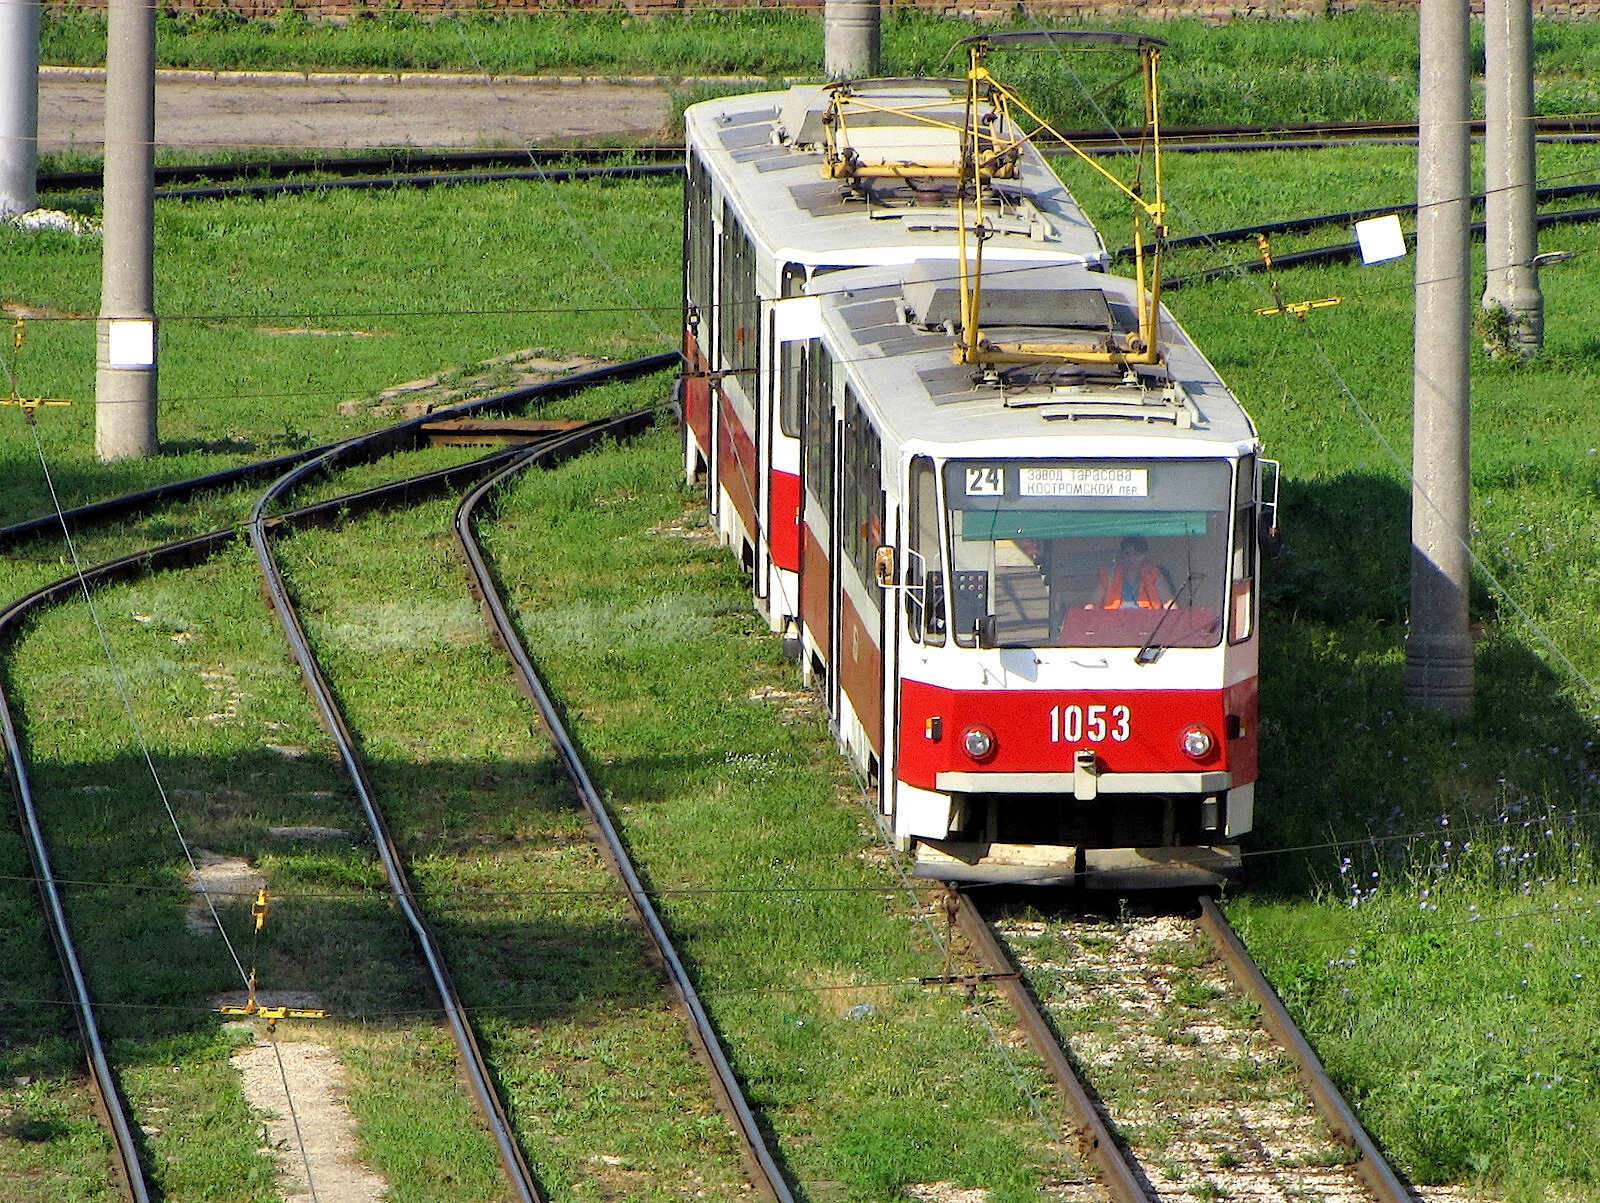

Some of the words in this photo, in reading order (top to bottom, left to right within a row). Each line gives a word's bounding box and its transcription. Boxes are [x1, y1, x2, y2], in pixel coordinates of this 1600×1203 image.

[970, 467, 999, 491] 24
[1027, 482, 1113, 495] КОСТРОМСКОЙ
[1050, 705, 1130, 742] 1053
